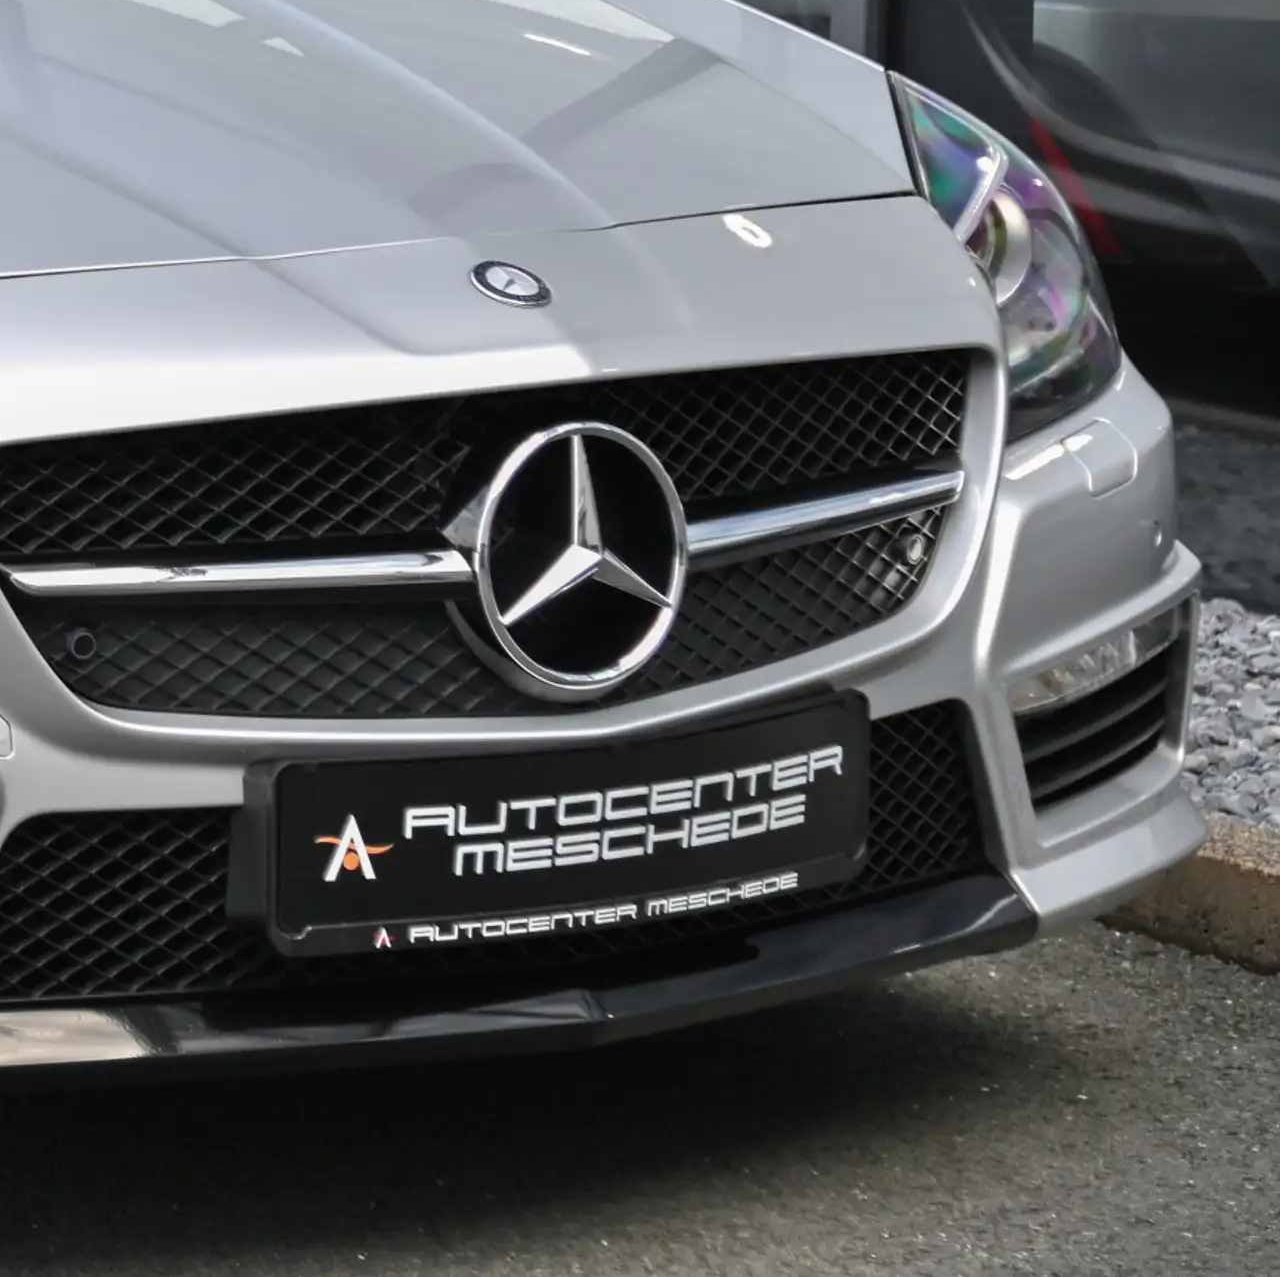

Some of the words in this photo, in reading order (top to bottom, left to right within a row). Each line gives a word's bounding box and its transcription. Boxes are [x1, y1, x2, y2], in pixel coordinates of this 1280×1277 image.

[403, 744, 844, 840] AUTOCENTER
[453, 794, 807, 876] MESCHEDE
[408, 903, 638, 943] AUTOCENTER
[646, 872, 799, 917] MESCHEDE
